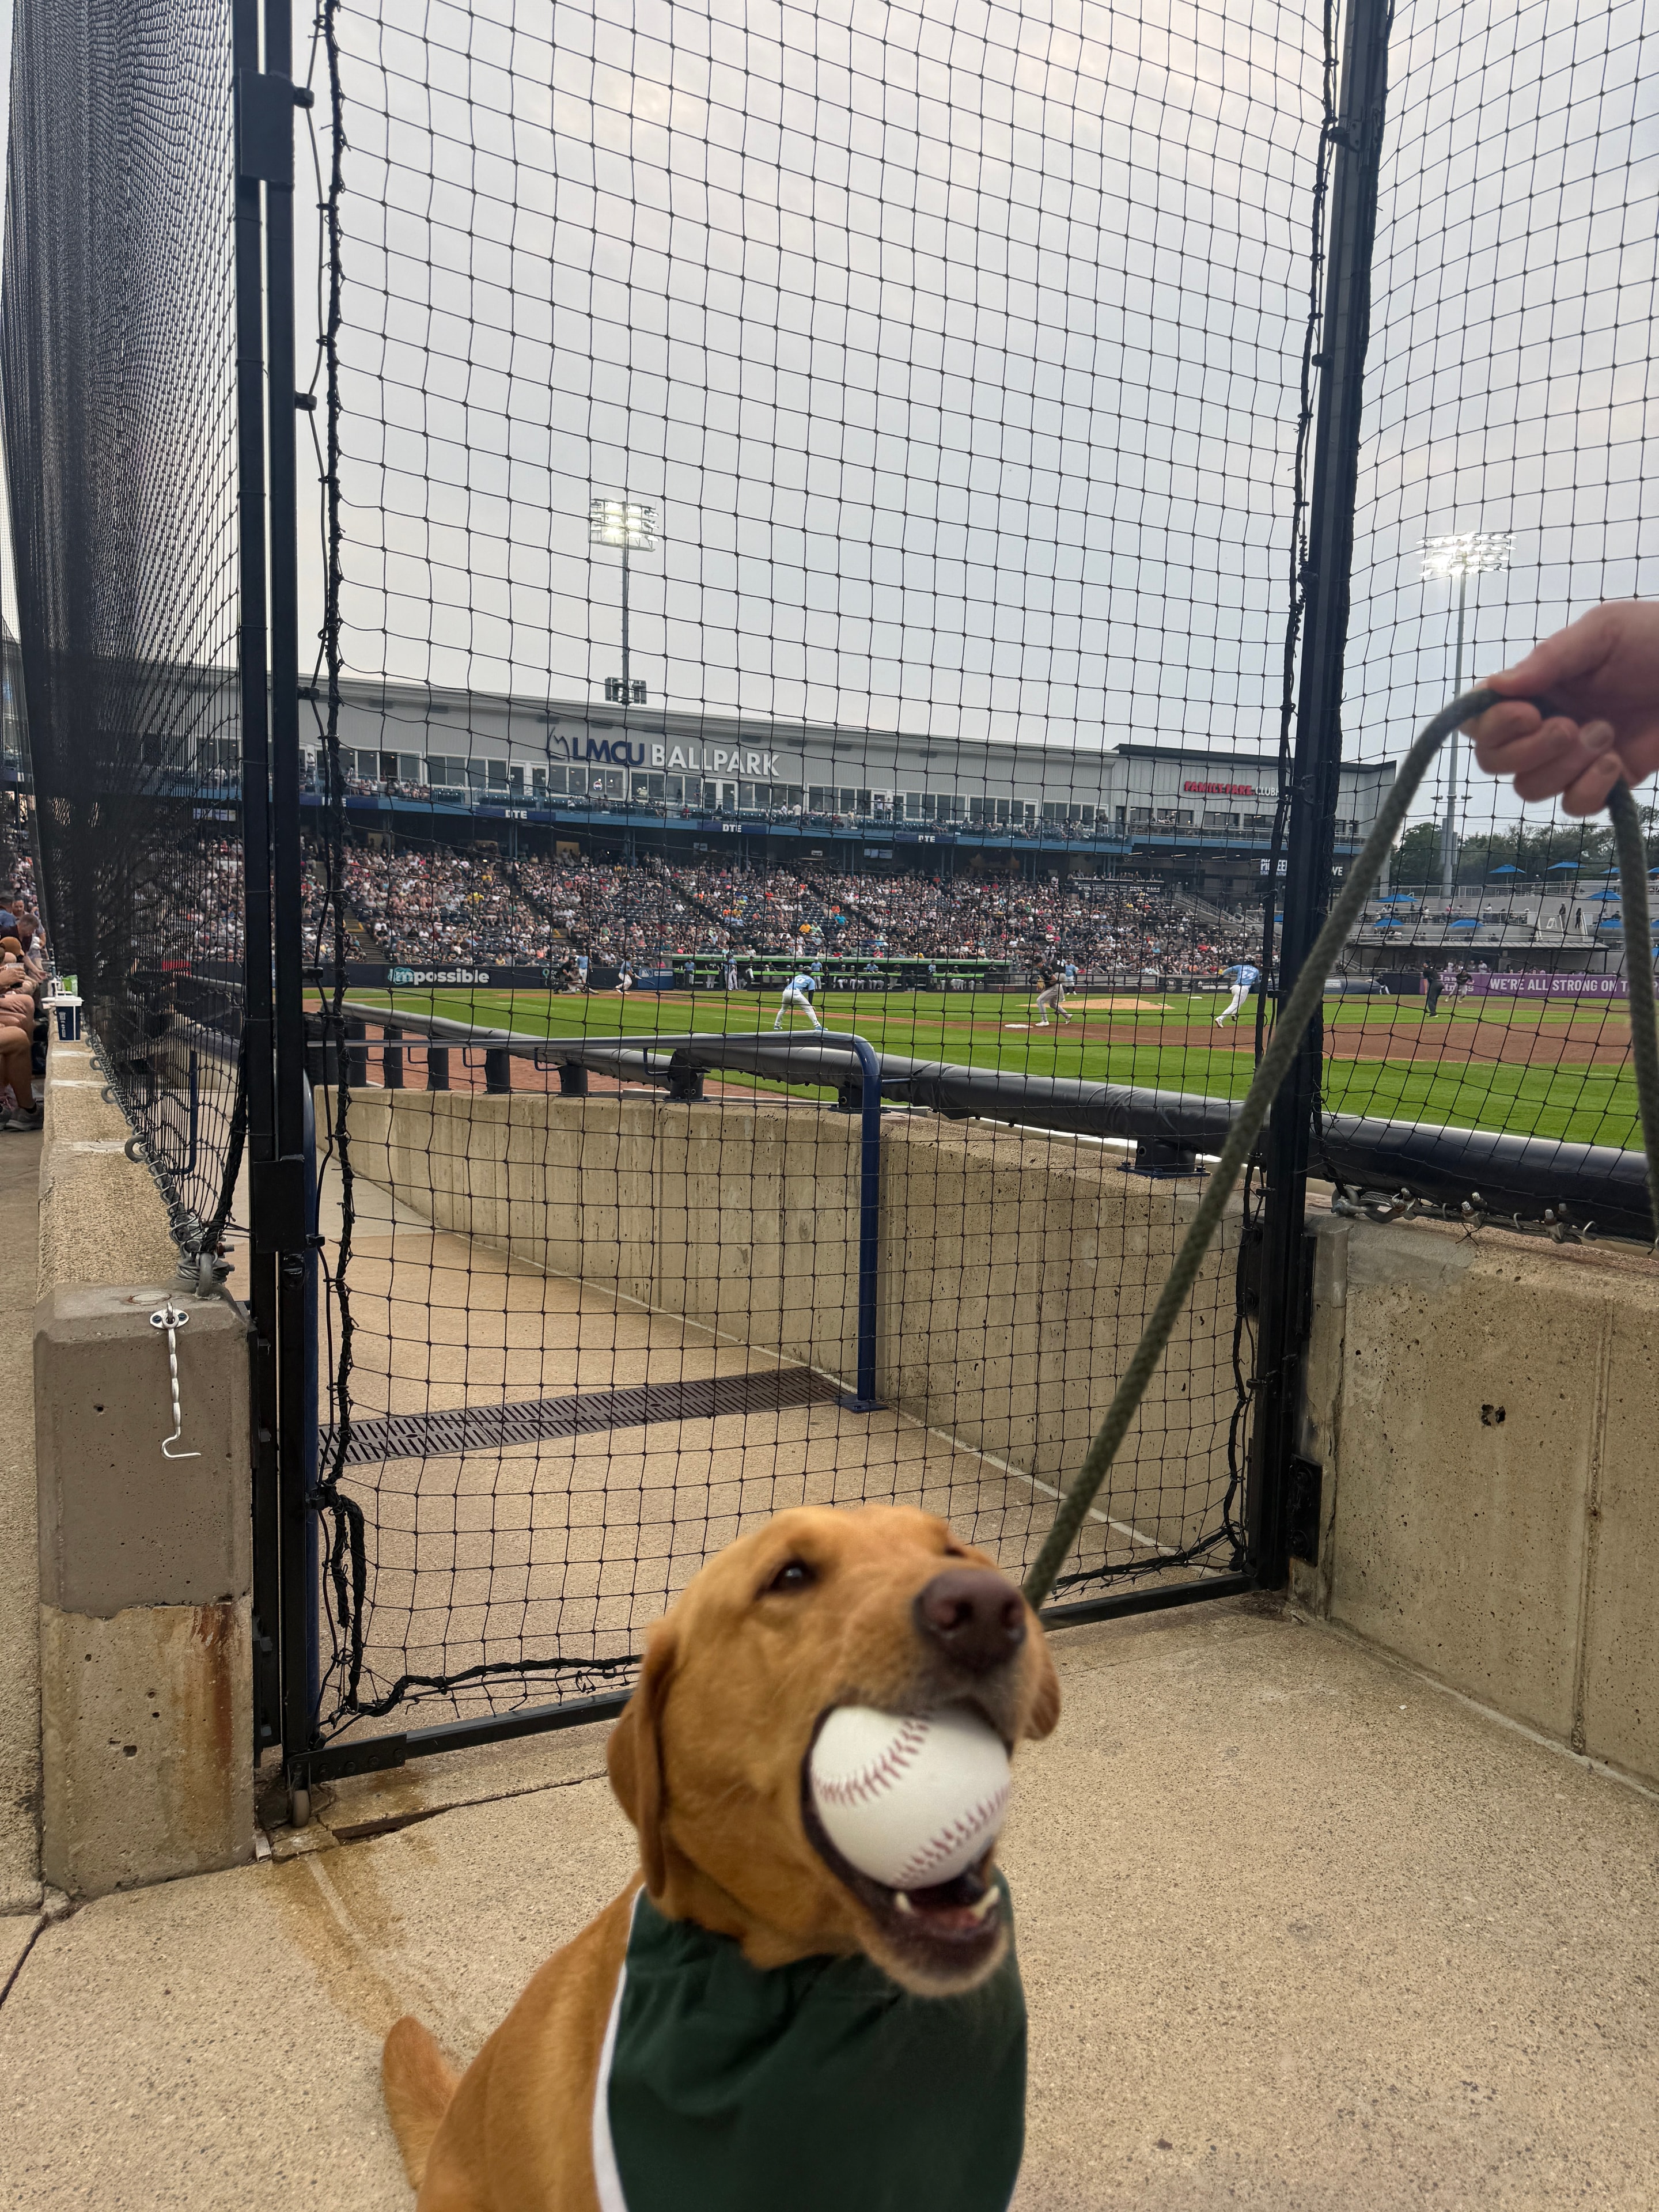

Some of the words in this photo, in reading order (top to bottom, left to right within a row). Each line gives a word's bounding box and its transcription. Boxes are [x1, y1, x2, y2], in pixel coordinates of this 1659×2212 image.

[573, 737, 645, 765] LMCU
[652, 744, 780, 777] BALLPARK
[1184, 781, 1224, 794] FAMILY
[505, 809, 528, 819] DTE
[722, 824, 742, 833] DTE
[918, 835, 935, 843] DTE
[389, 967, 490, 986] Impossible
[1490, 978, 1524, 991] WE'RE
[1527, 979, 1548, 991] ALL
[1552, 979, 1598, 992] STRONG
[1601, 980, 1618, 992] ON
